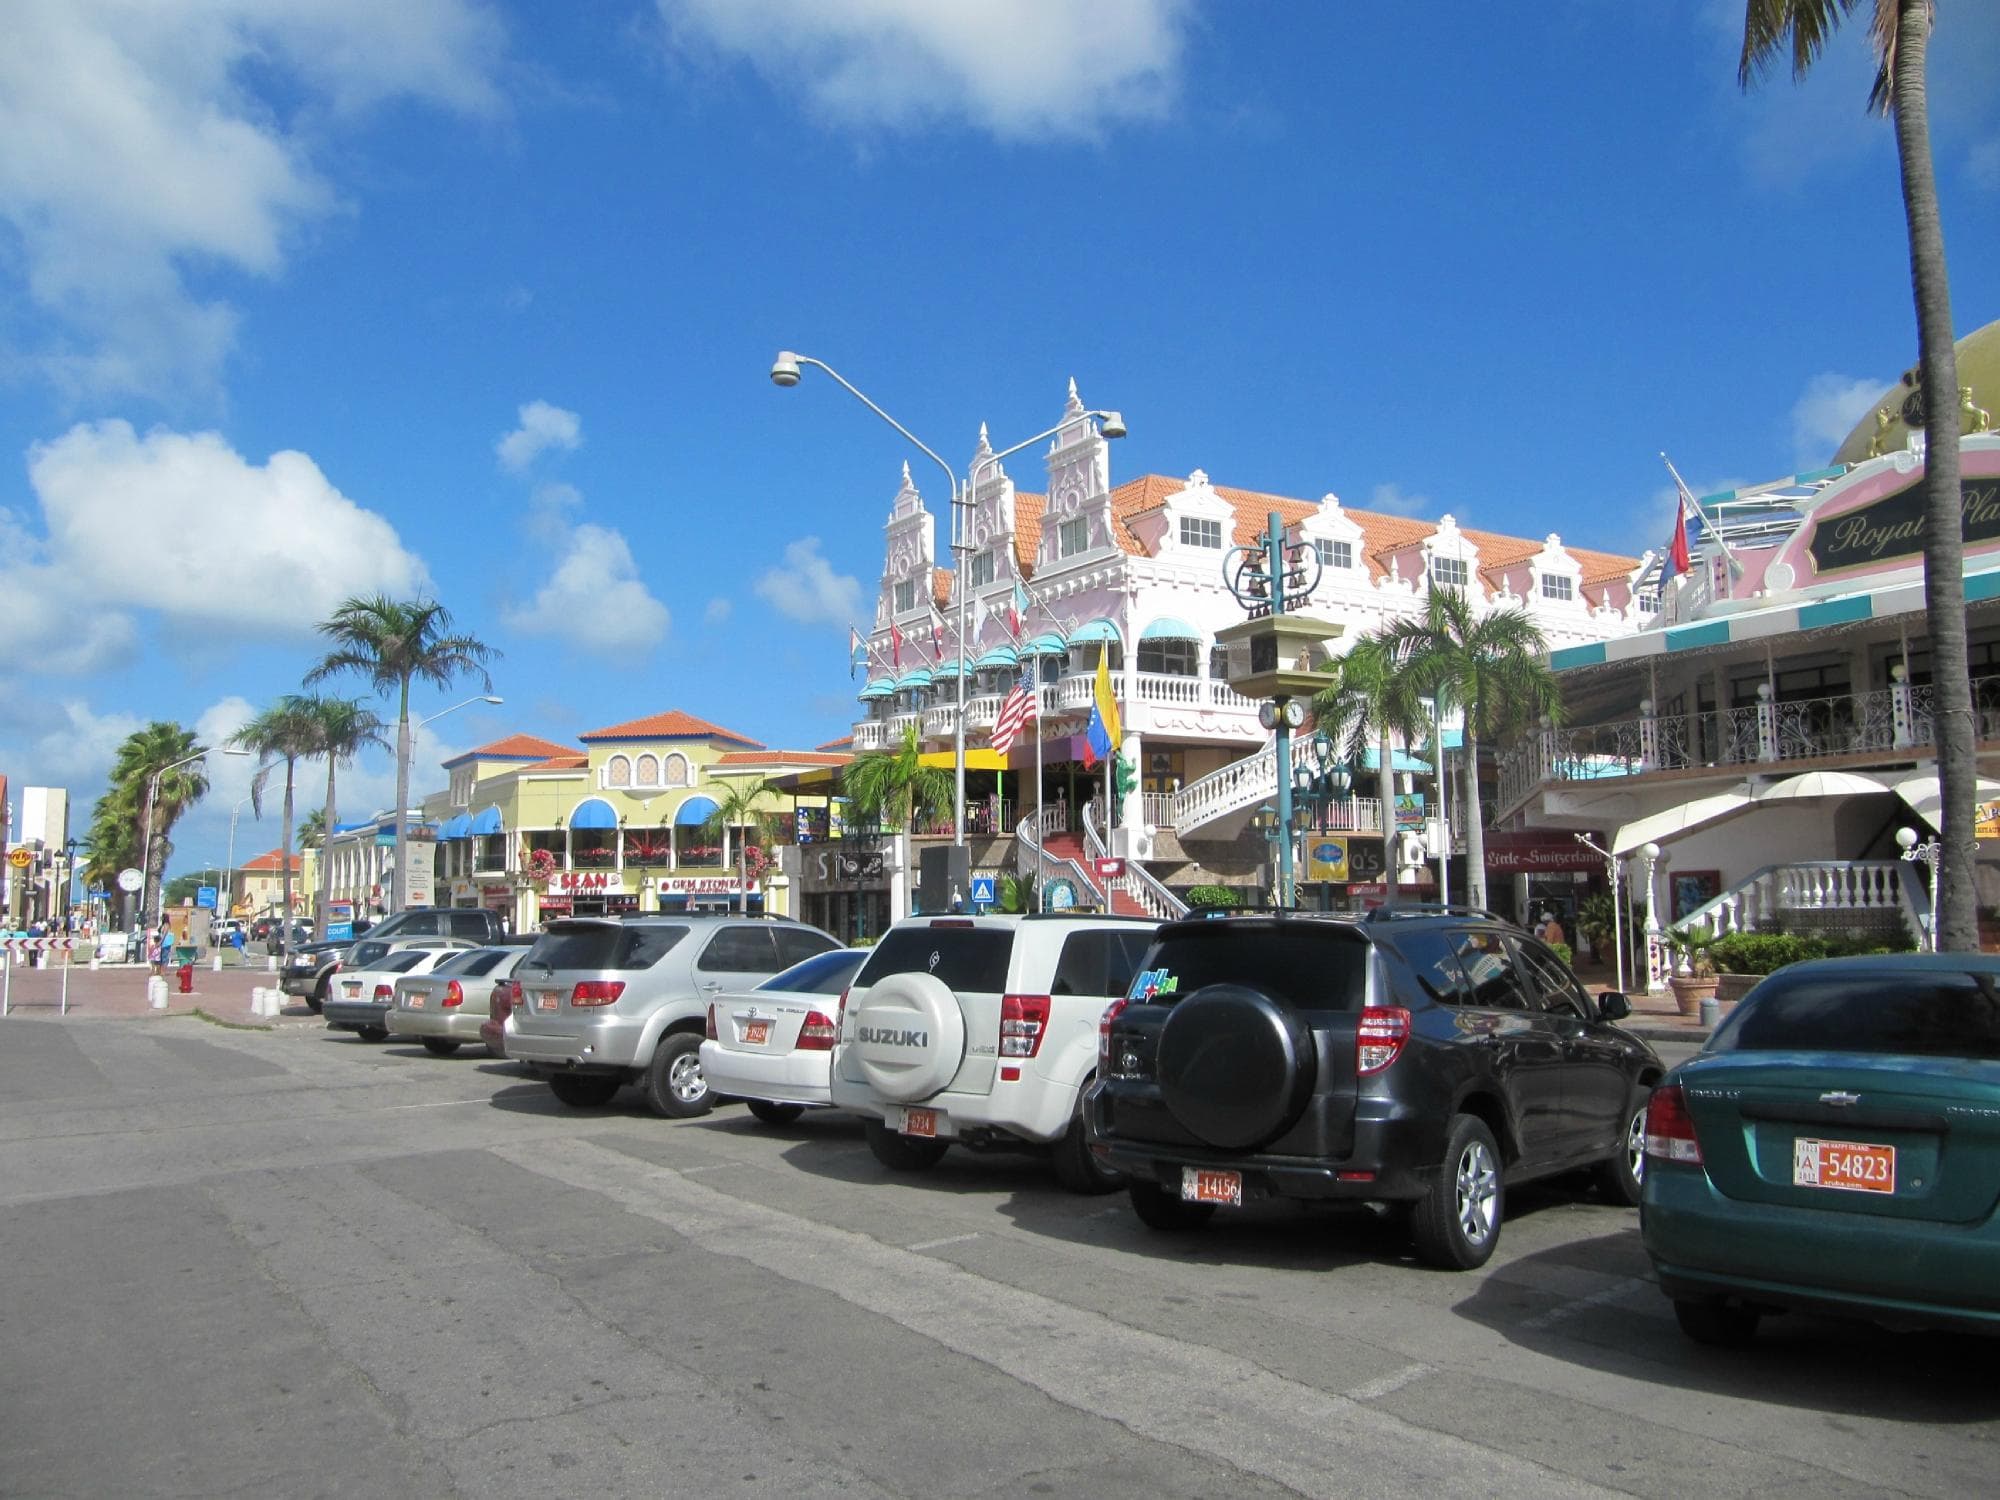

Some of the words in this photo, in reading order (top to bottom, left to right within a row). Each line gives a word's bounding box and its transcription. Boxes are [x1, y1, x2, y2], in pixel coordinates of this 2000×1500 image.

[1828, 515, 1925, 555] Royal
[1488, 850, 1519, 867] Little
[1522, 849, 1604, 867] Switzerland
[560, 872, 608, 889] SEAN
[672, 879, 697, 890] GEM
[327, 926, 350, 936] COURT
[858, 1026, 929, 1049] SUZUKI
[1802, 1155, 1813, 1169] A
